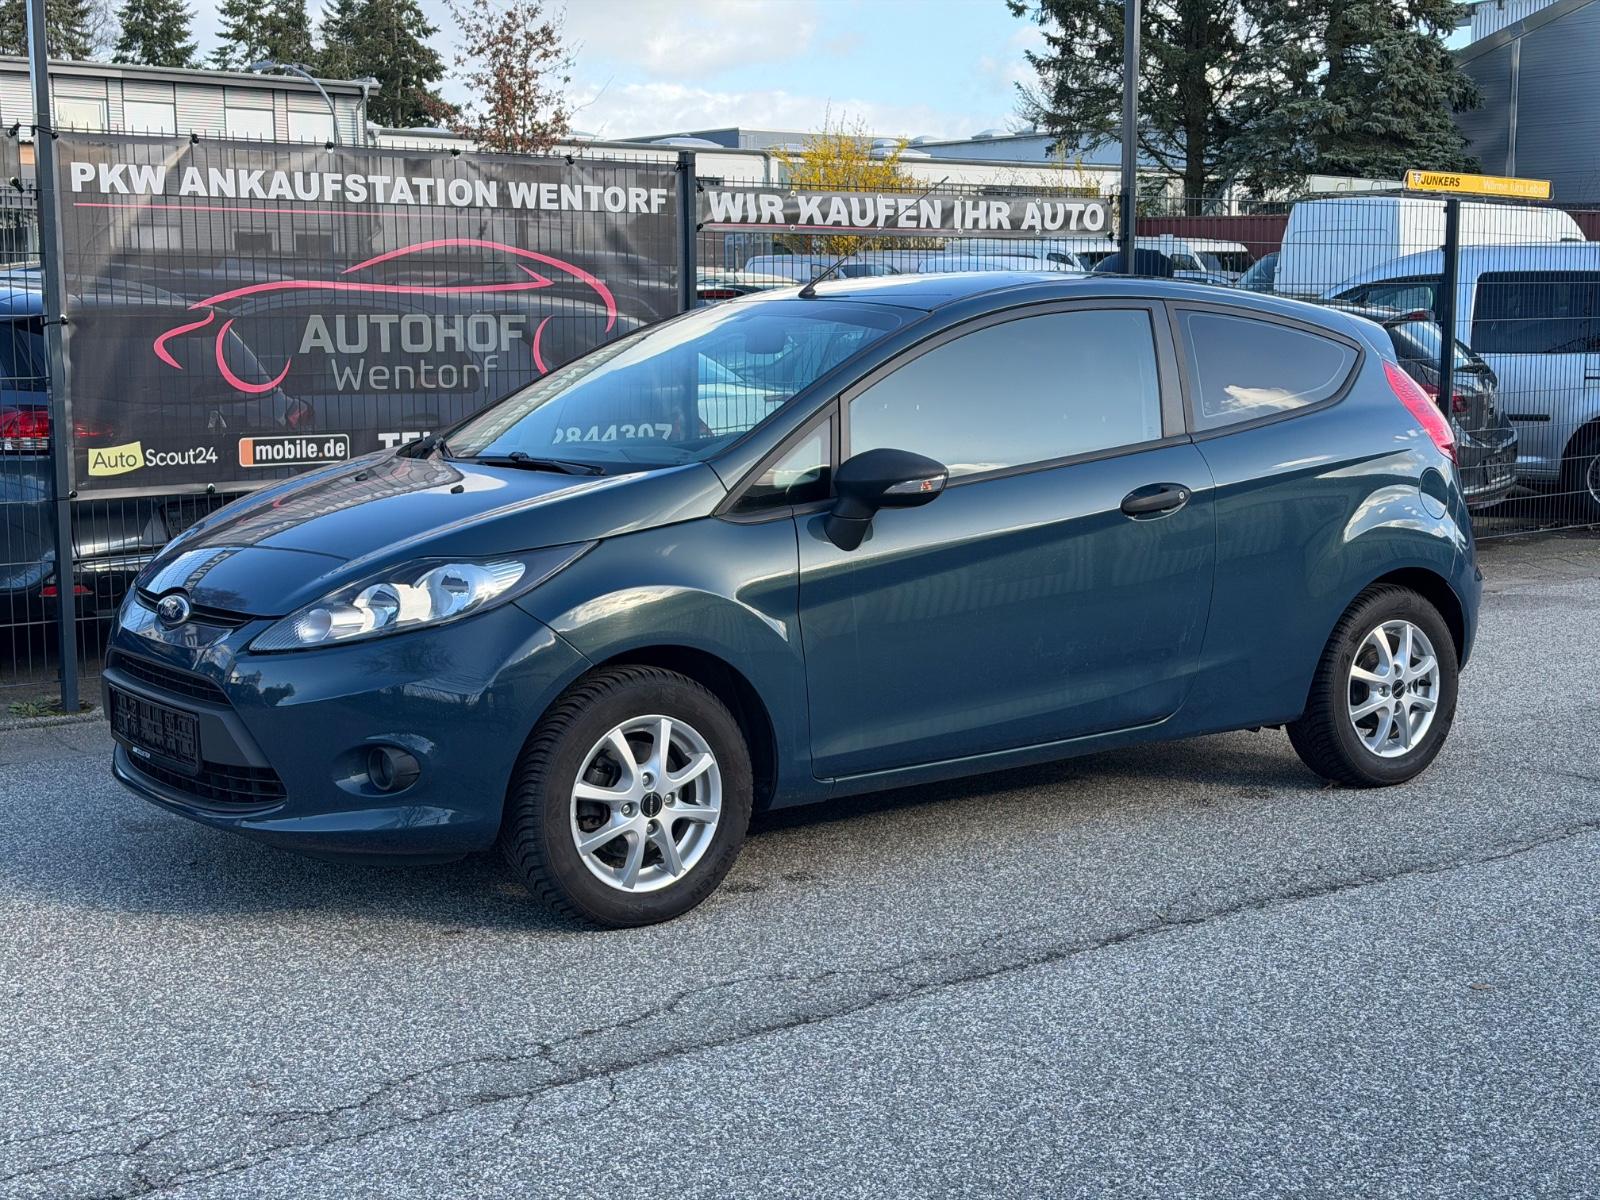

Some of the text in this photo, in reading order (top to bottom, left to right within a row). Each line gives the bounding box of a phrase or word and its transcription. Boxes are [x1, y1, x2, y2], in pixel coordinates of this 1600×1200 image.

[70, 161, 667, 214] PKW ANKAUFSTATION WENTORF
[1421, 176, 1460, 187] JUNKERS
[709, 191, 1105, 231] WIR KAUFEN IHR AUTO
[299, 314, 527, 354] AUTOHOF
[331, 354, 498, 391] Wentorf
[255, 439, 345, 460] mobile.de
